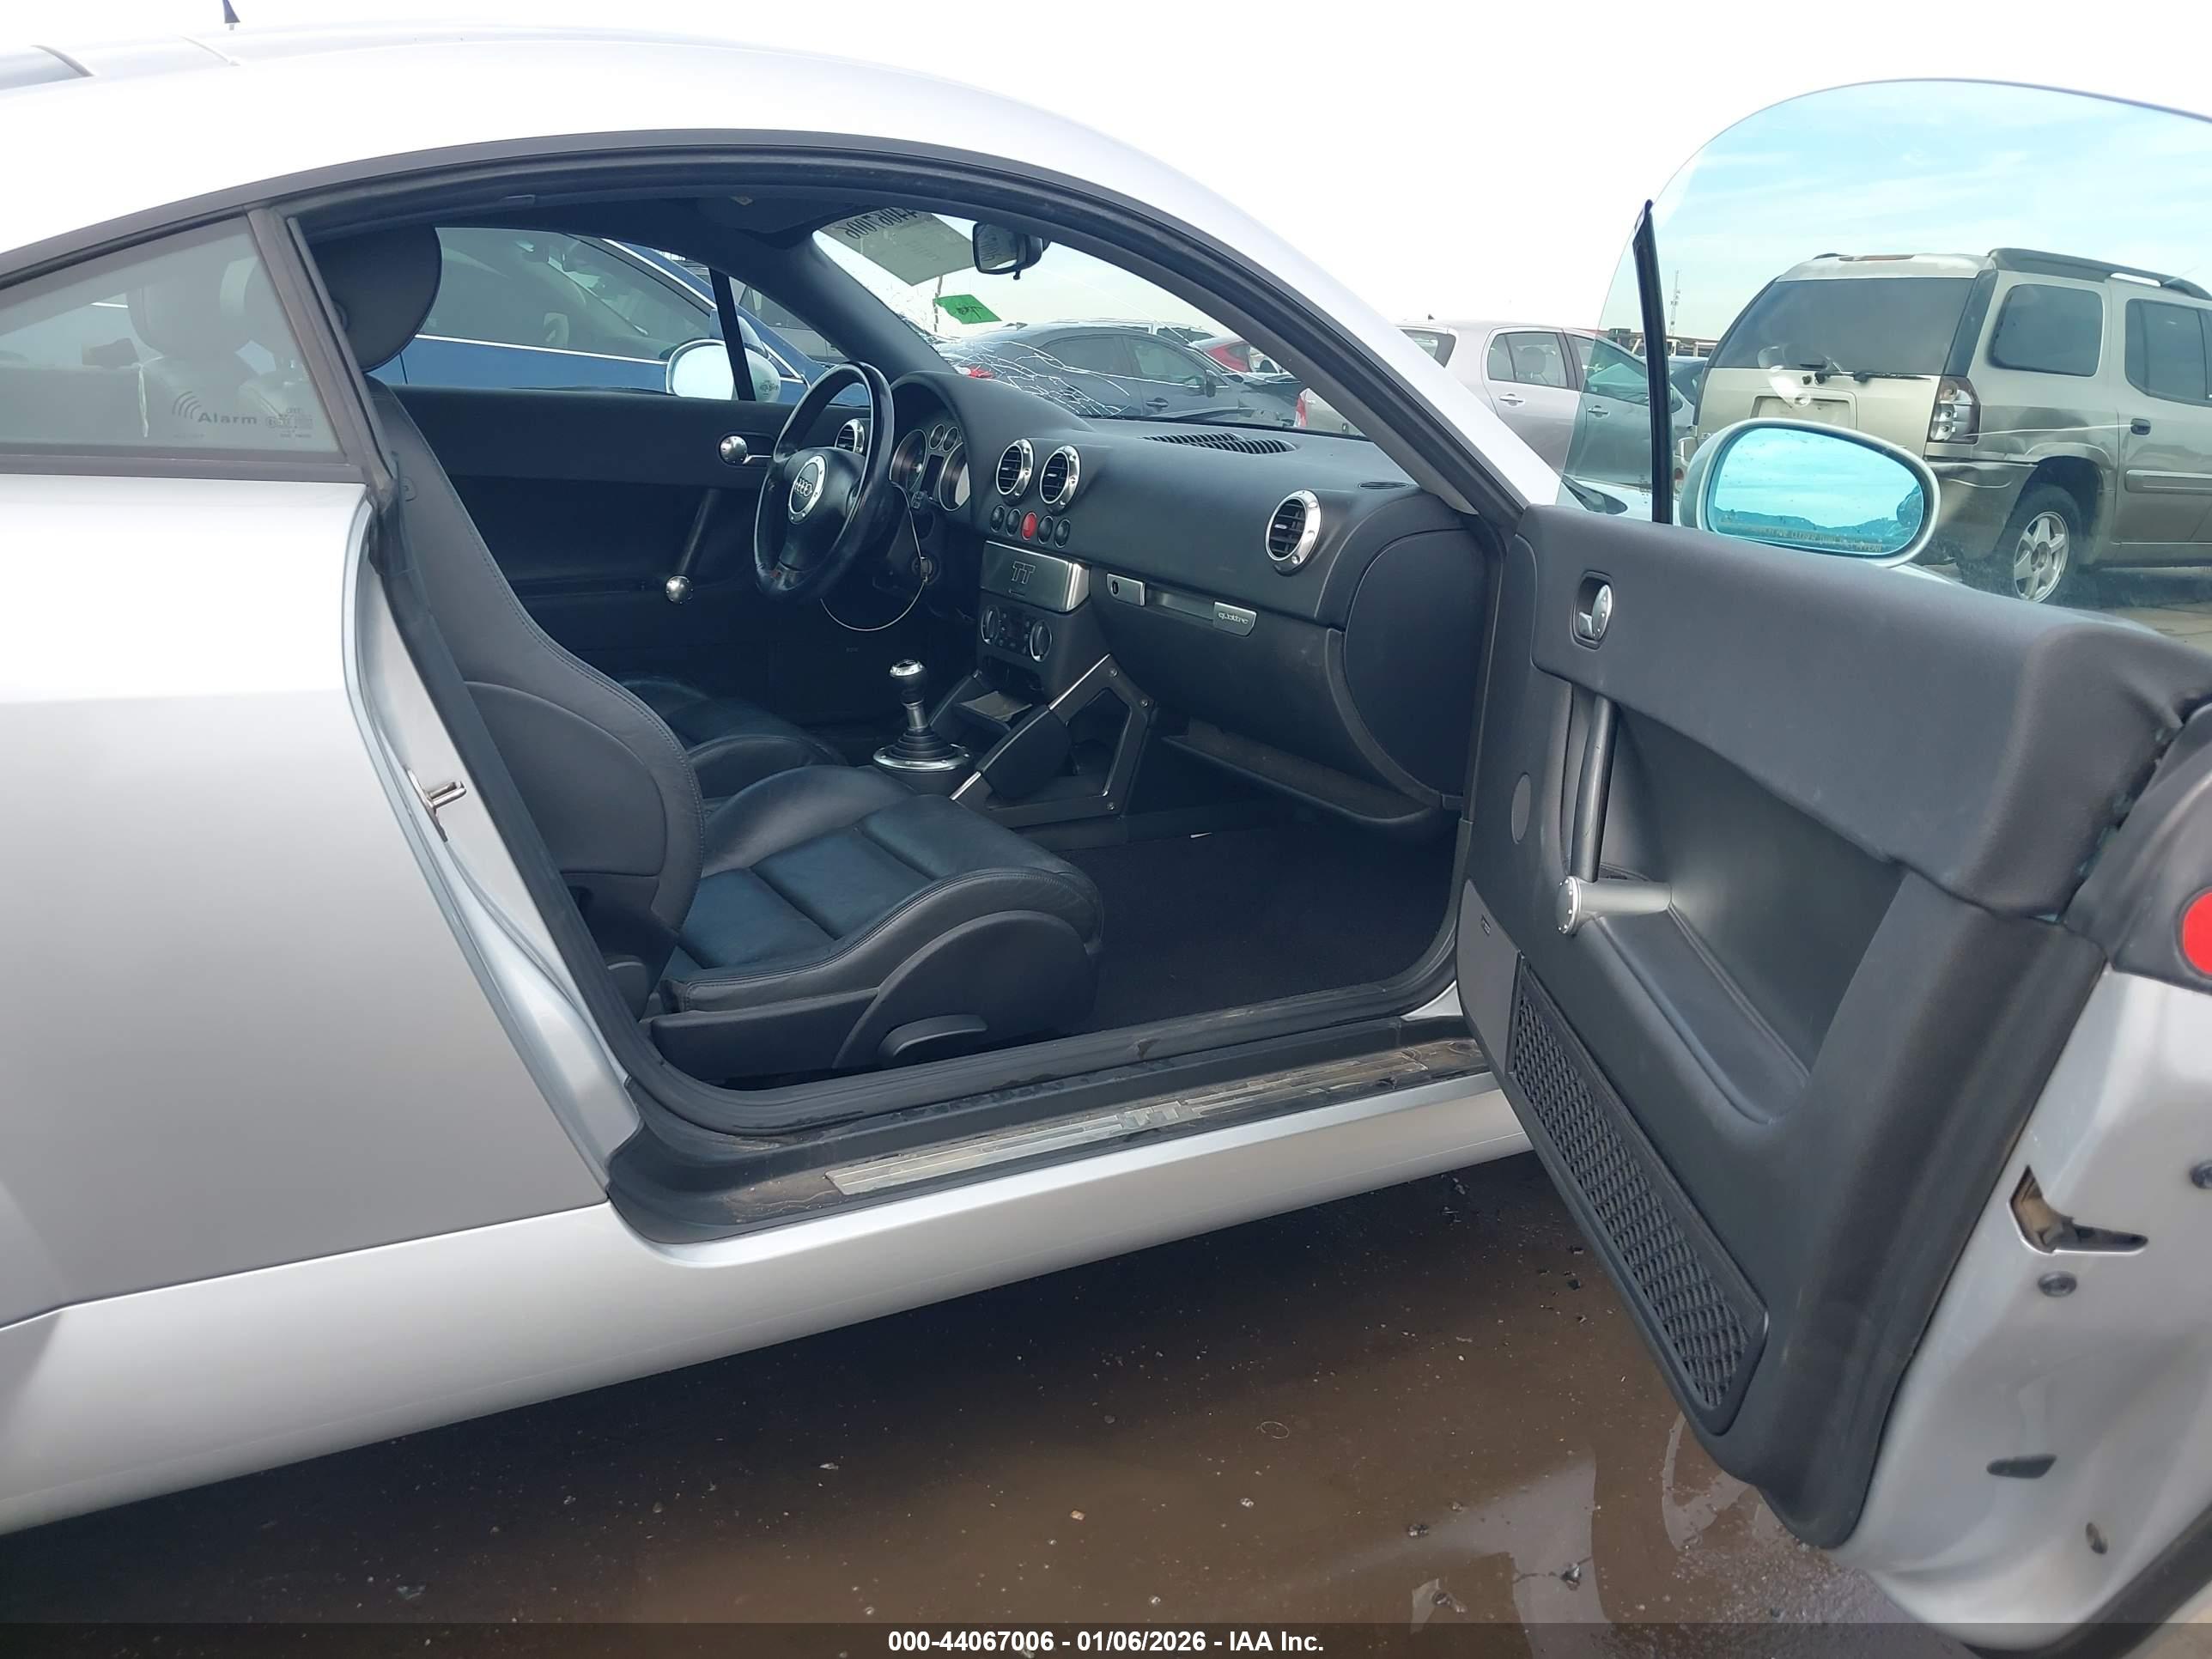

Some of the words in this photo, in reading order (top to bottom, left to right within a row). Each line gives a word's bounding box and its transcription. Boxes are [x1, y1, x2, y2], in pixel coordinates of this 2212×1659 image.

[198, 412, 257, 426] Alarm
[1011, 561, 1036, 585] TT
[1123, 1100, 1182, 1127] TT
